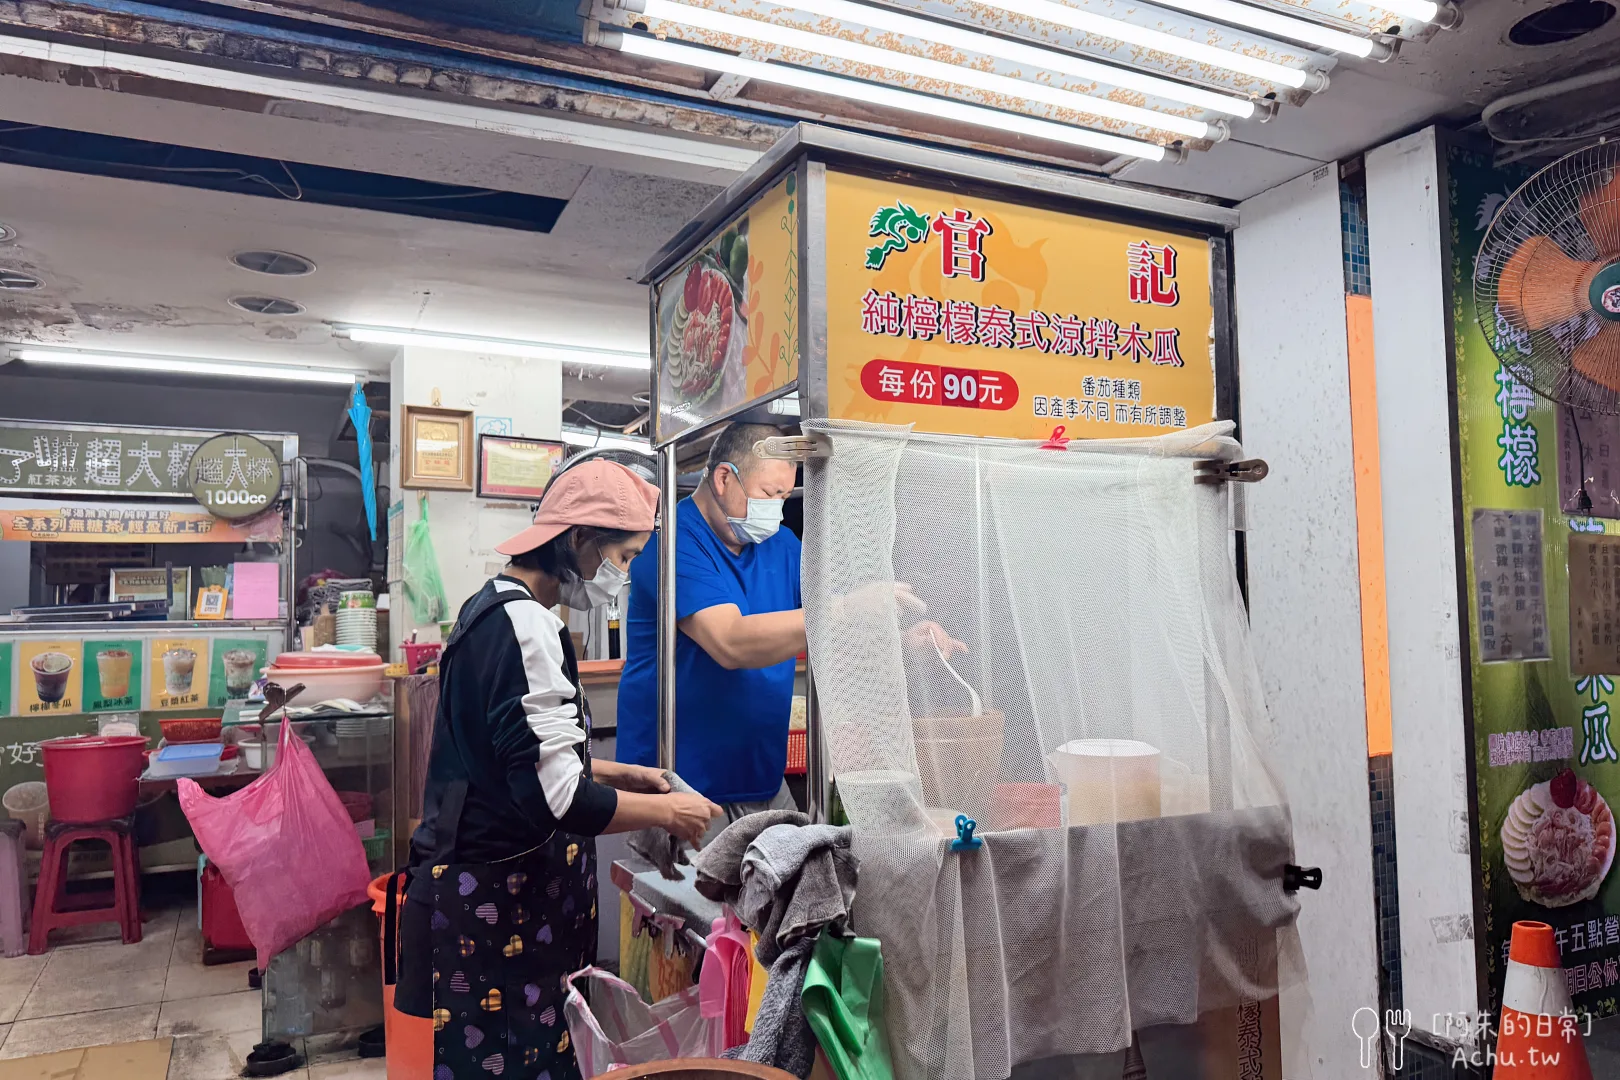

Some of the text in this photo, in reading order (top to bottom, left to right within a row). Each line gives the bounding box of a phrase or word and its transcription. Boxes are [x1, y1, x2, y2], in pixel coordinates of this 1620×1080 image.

[933, 206, 1180, 306] 官 記
[860, 288, 1184, 368] 純檸檬泰式涼拌木瓜
[878, 365, 1003, 405] 每份90元
[1082, 376, 1141, 401] 番茄種類
[1034, 396, 1187, 427] 因產季不同 而有所調整
[28, 473, 77, 487] 紅茶冰
[195, 437, 274, 489] 超大杯
[205, 490, 267, 505] 1000cc
